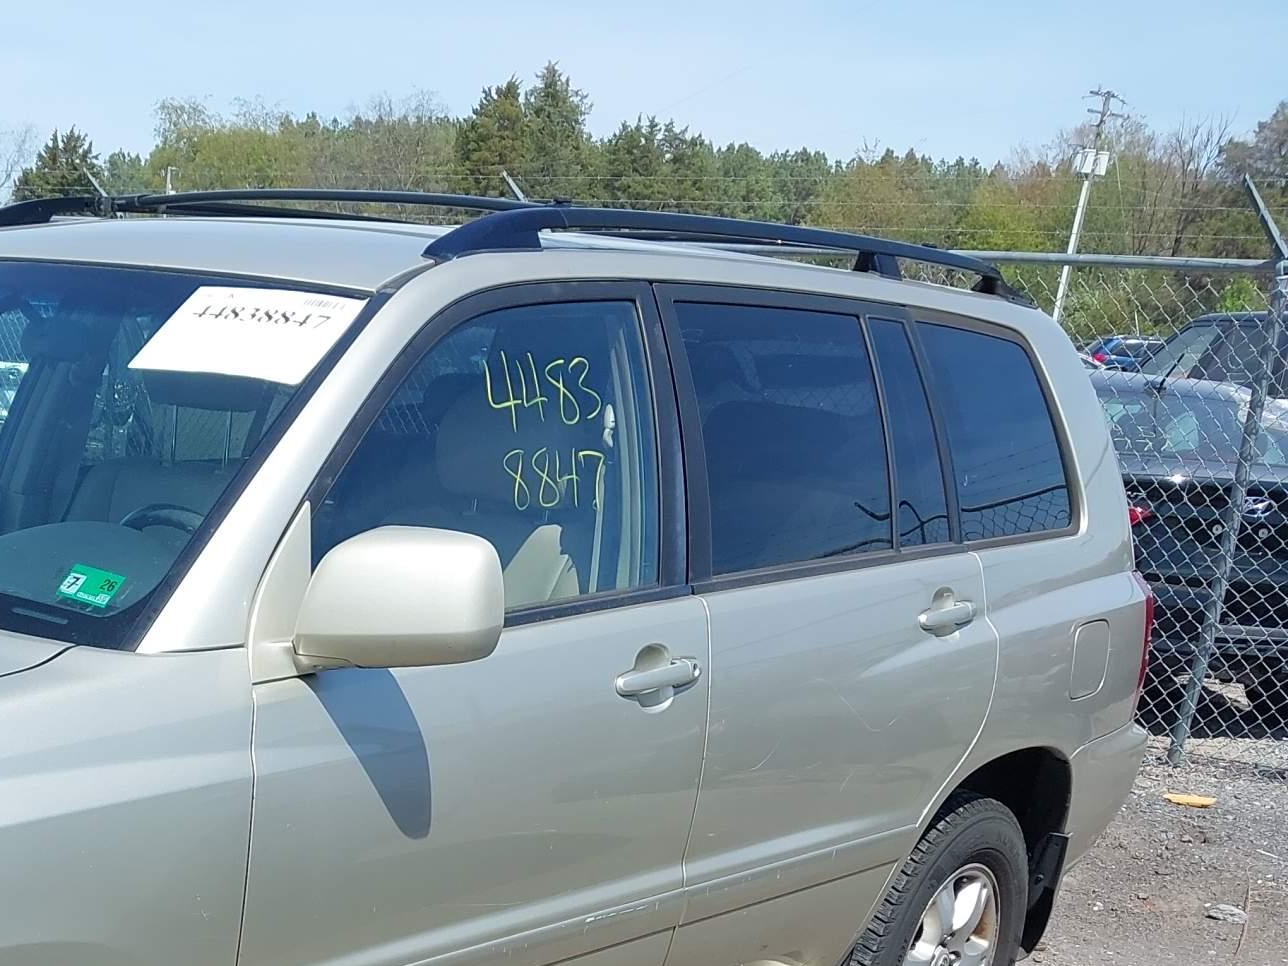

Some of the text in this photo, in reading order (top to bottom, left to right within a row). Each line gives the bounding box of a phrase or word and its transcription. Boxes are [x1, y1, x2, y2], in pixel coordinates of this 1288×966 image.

[193, 304, 331, 328] 44838847
[483, 351, 601, 432] 4483
[503, 447, 605, 511] 8847
[66, 576, 118, 592] 7 26
